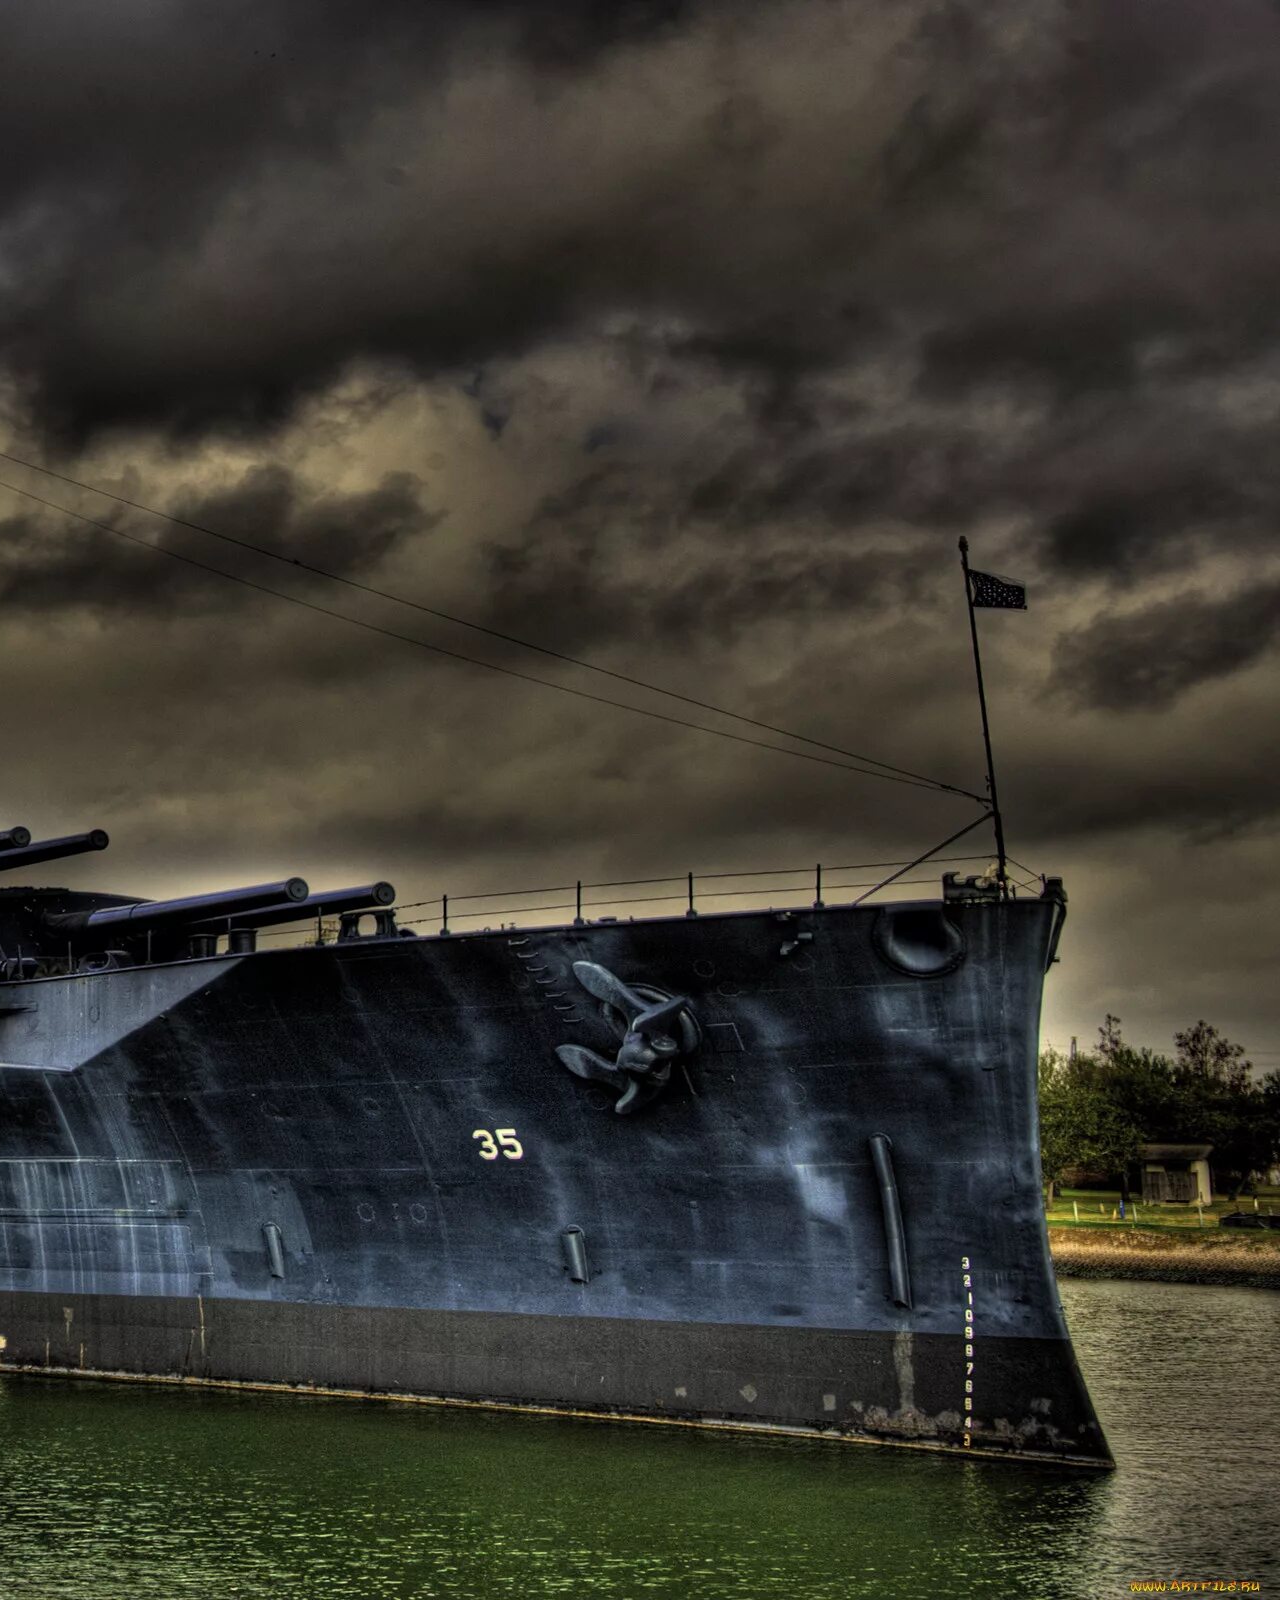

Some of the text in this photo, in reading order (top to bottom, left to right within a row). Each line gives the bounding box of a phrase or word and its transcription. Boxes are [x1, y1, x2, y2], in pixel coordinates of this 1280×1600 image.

[472, 1128, 524, 1160] 35
[961, 1256, 970, 1270] 3
[963, 1274, 972, 1287] 2
[966, 1361, 974, 1375] 7
